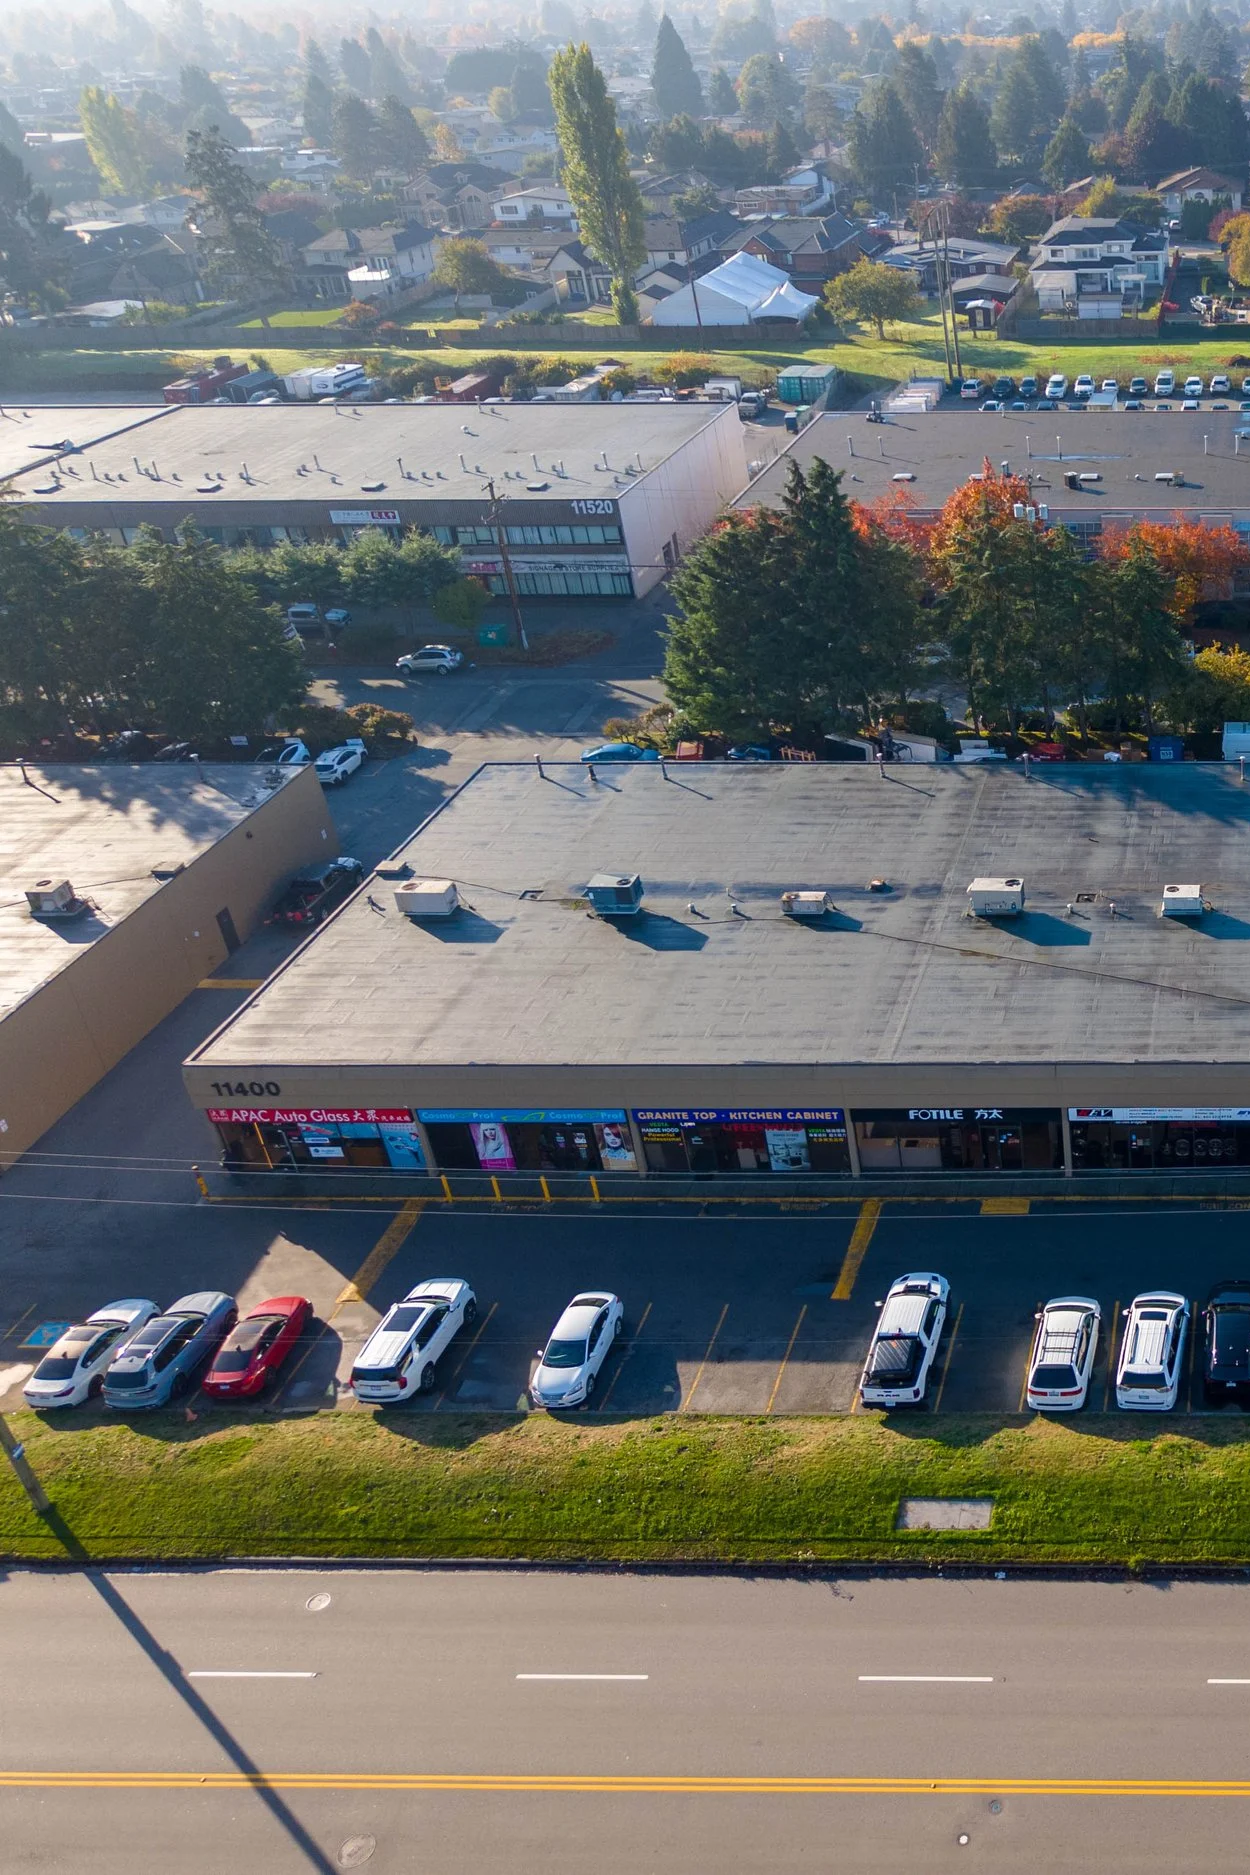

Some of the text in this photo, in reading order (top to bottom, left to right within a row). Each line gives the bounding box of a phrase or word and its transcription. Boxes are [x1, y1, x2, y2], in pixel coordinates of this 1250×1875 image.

[571, 500, 614, 514] 11520
[211, 1082, 281, 1097] 11400
[231, 1110, 350, 1122] APAC Auto Glass
[422, 1112, 456, 1120] Cosmo
[549, 1112, 583, 1120] Cosmo
[637, 1111, 839, 1120] GRANITE TOP KITCHEN CABINET
[908, 1109, 1003, 1120] FOTILE 方太
